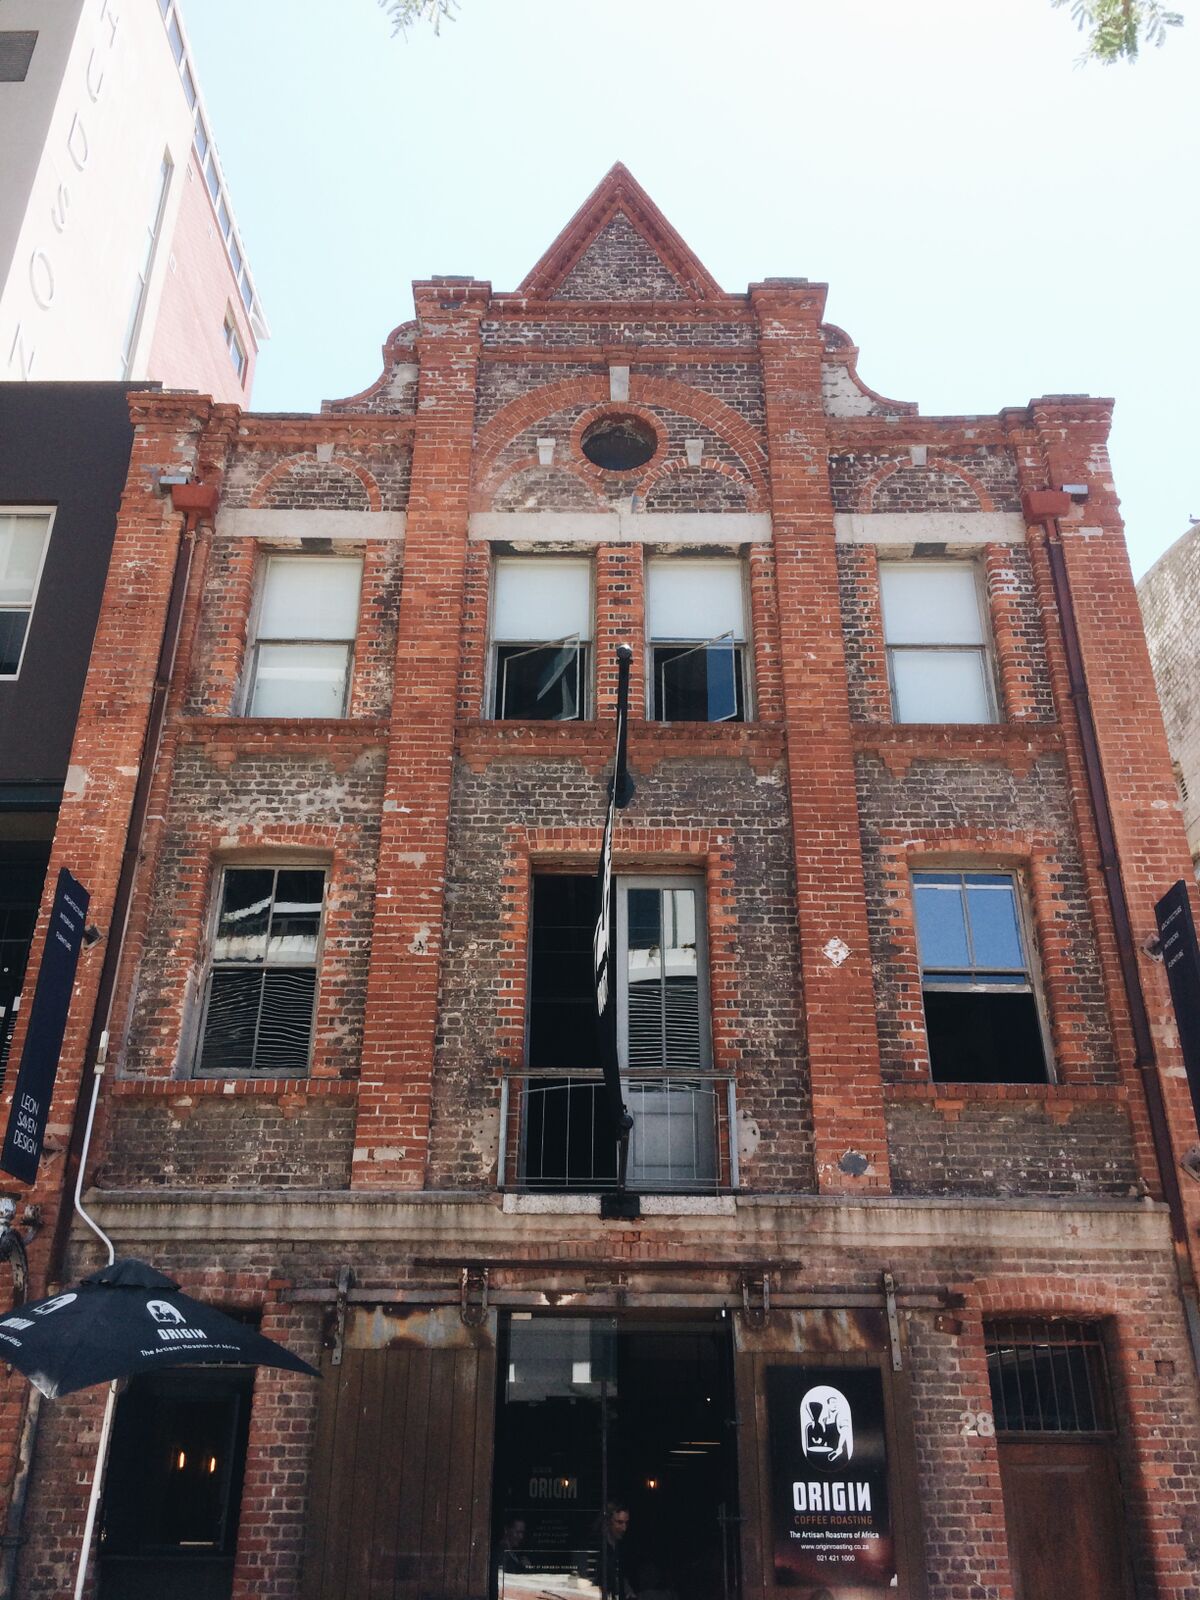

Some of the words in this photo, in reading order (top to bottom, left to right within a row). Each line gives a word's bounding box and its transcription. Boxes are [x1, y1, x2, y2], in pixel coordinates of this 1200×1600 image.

[21, 1092, 39, 1115] LEON
[13, 1129, 38, 1155] DESIGN
[157, 1328, 208, 1340] ORIGIN
[140, 1349, 155, 1357] The
[155, 1346, 182, 1354] Artisan
[960, 1411, 996, 1437] 28
[792, 1481, 872, 1512] ORIGIN
[794, 1515, 828, 1525] COFFEE
[830, 1515, 873, 1525] ROASTING
[789, 1530, 801, 1539] The
[801, 1530, 825, 1539] Artisan
[825, 1530, 853, 1539] Roasters
[853, 1531, 861, 1539] of
[861, 1531, 880, 1539] Africa
